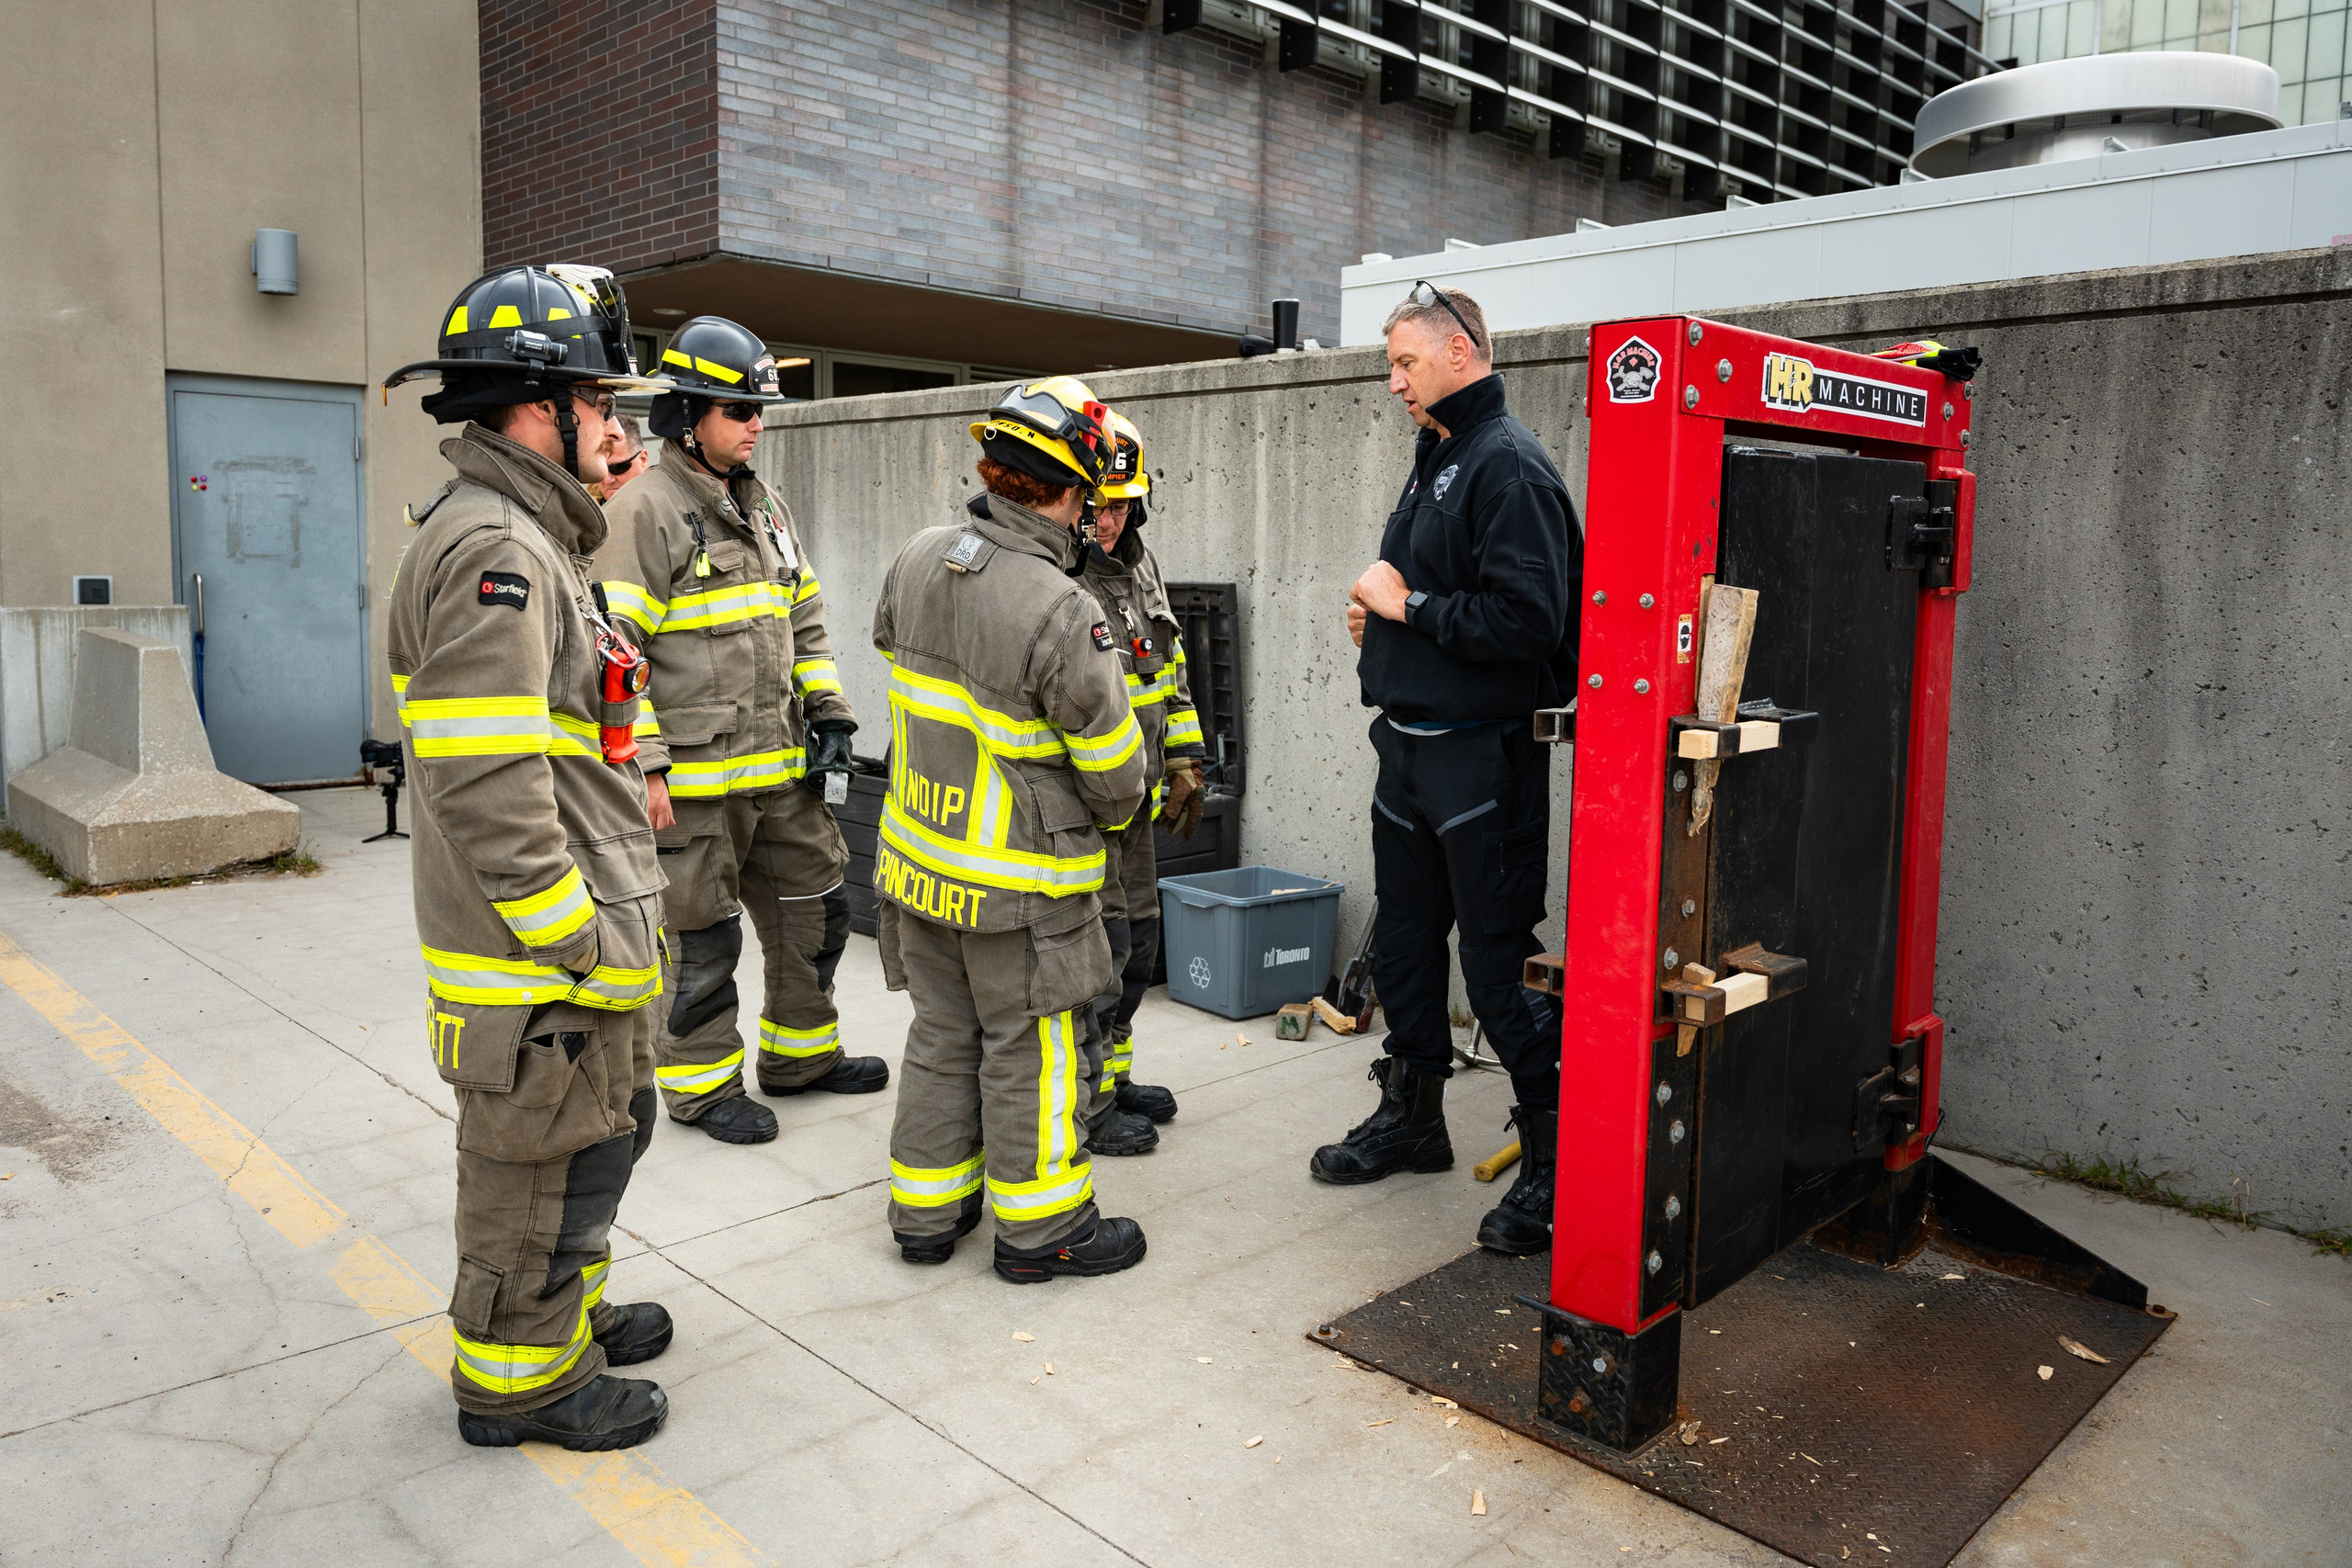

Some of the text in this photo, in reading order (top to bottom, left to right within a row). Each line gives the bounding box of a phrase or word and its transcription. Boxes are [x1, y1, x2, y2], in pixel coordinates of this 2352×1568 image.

[768, 368, 780, 382] 68
[1819, 378, 1918, 417] MACHINE
[956, 547, 971, 559] DRD
[493, 583, 525, 598] Starfield
[906, 768, 965, 826] NDIP
[876, 847, 987, 928] PINCOURT
[1280, 1015, 1301, 1035] M
